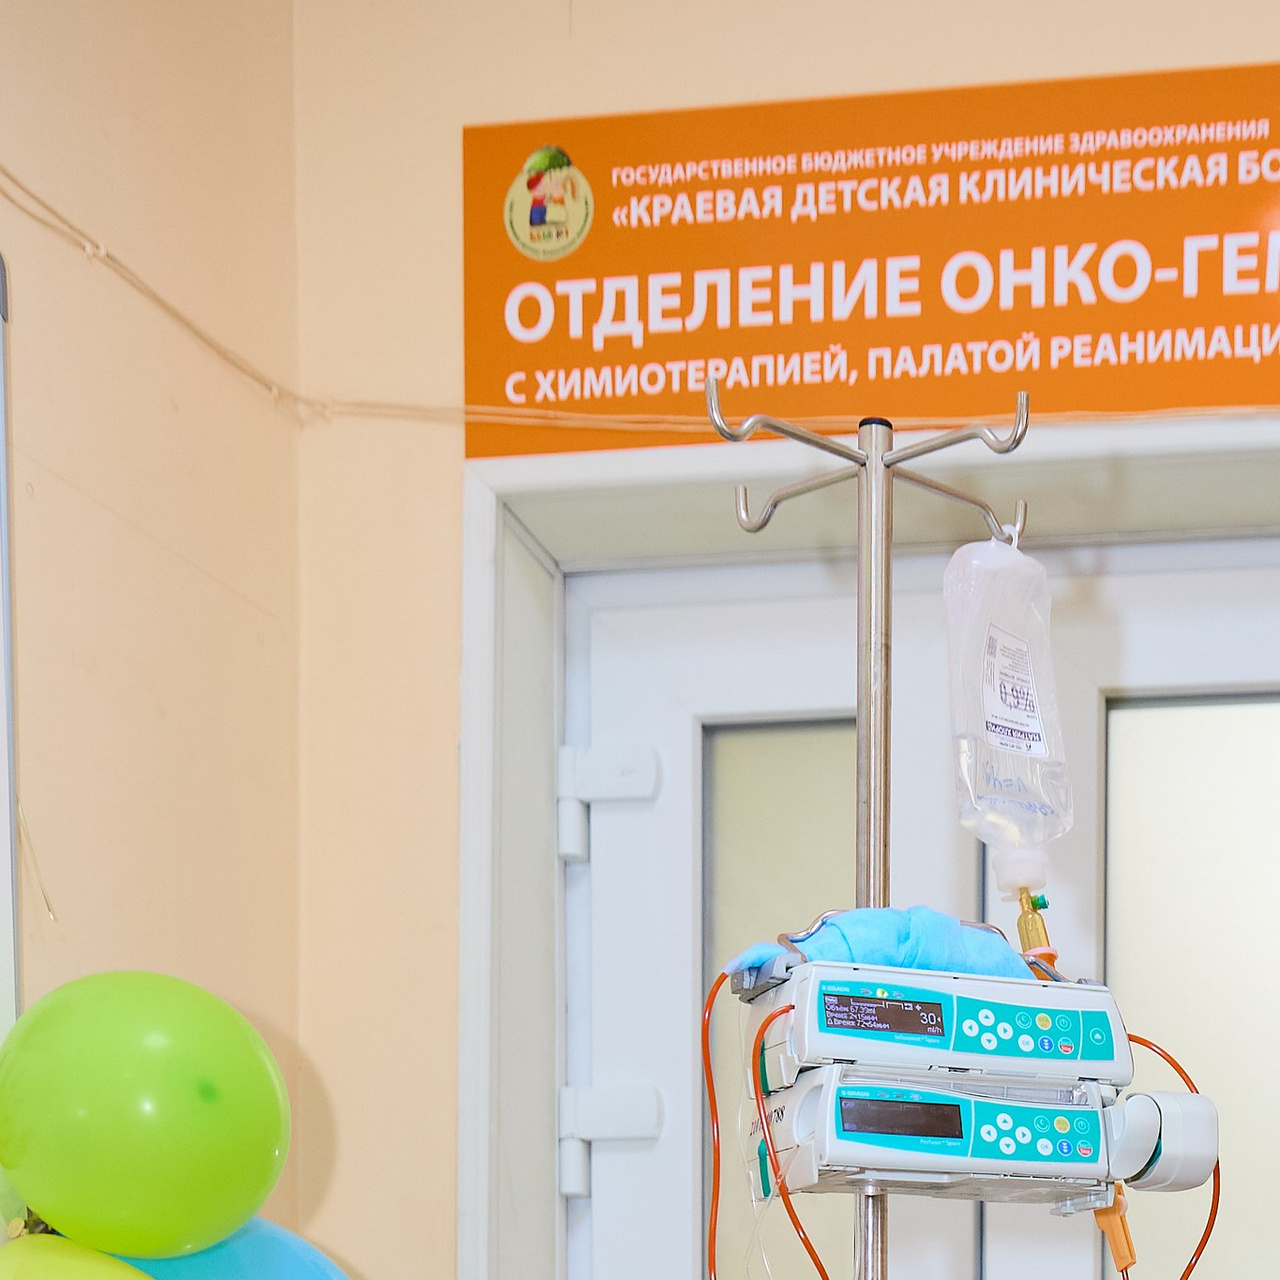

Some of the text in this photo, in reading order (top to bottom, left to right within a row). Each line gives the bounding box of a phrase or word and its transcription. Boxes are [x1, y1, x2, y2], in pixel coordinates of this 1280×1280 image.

[612, 119, 1270, 187] ГОСУДАРСТВЕННОЕ БЮДЖЕТНОЕ УЧРЕЖДЕНИЕ ЗДРАВООХРАНЕНИЯ
[612, 186, 782, 228] «КРАЕВАЯ
[790, 174, 950, 222] ДЕТСКАЯ
[959, 151, 1227, 201] КЛИНИЧЕСКАЯ
[504, 255, 922, 350] ОТДЕЛЕНИЕ
[505, 370, 526, 404] С
[536, 344, 859, 401] ХИМИОТЕРАПИЕЙ,
[867, 332, 1040, 379] ПАЛАТОЙ
[919, 1013, 937, 1025] 30
